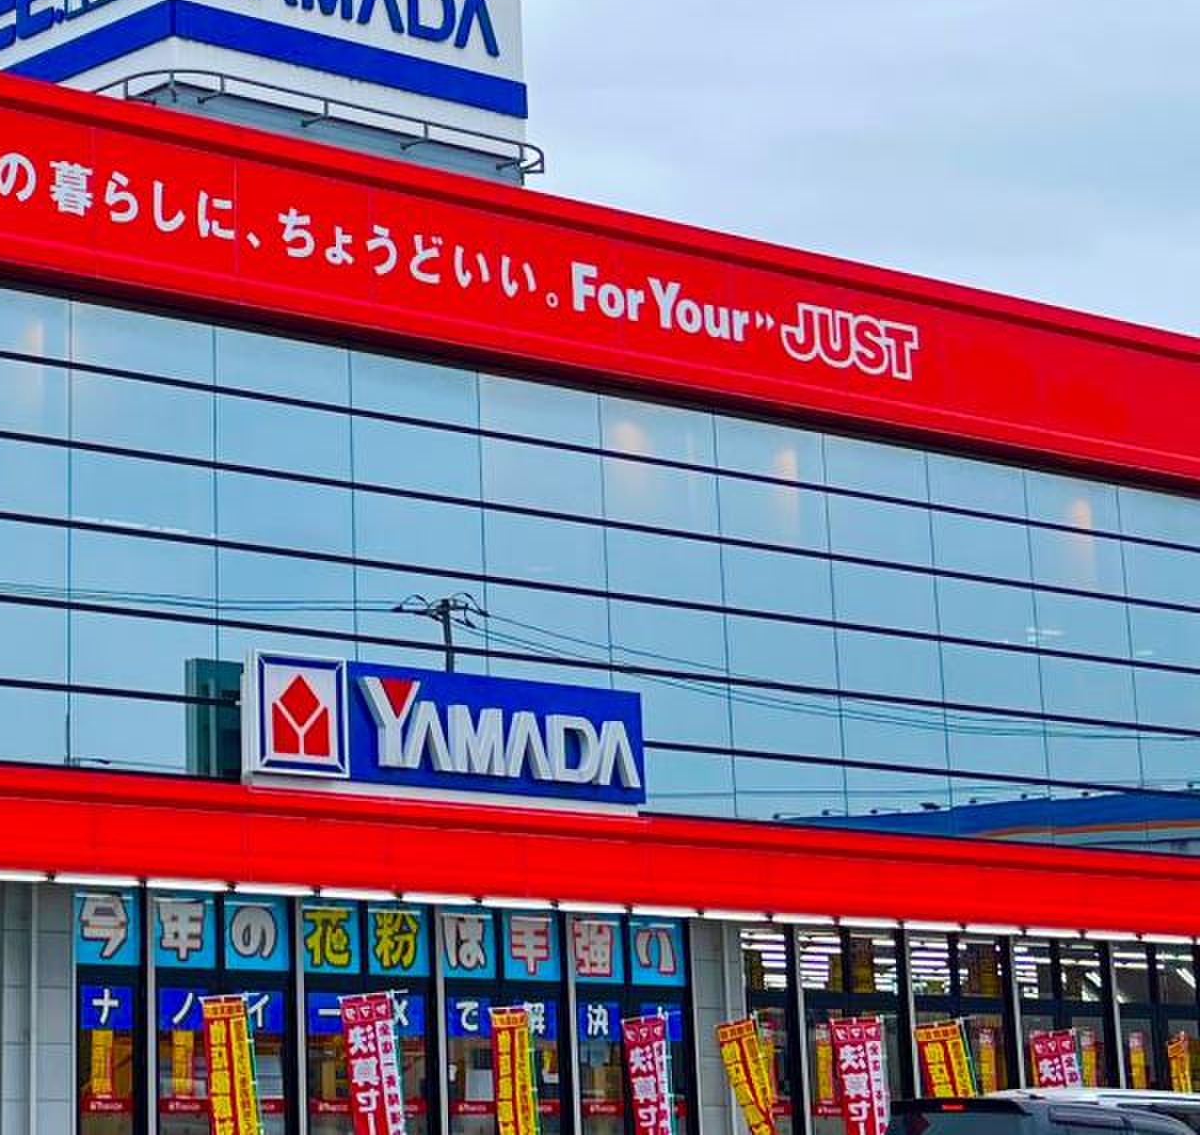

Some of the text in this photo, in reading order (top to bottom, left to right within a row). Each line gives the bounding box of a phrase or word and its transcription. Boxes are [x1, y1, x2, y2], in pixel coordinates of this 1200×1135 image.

[570, 261, 645, 322] For
[648, 276, 750, 343] Your
[780, 302, 920, 381] JUST
[357, 675, 641, 788] YAMADA
[79, 893, 678, 977] 今年の花粉は手強い
